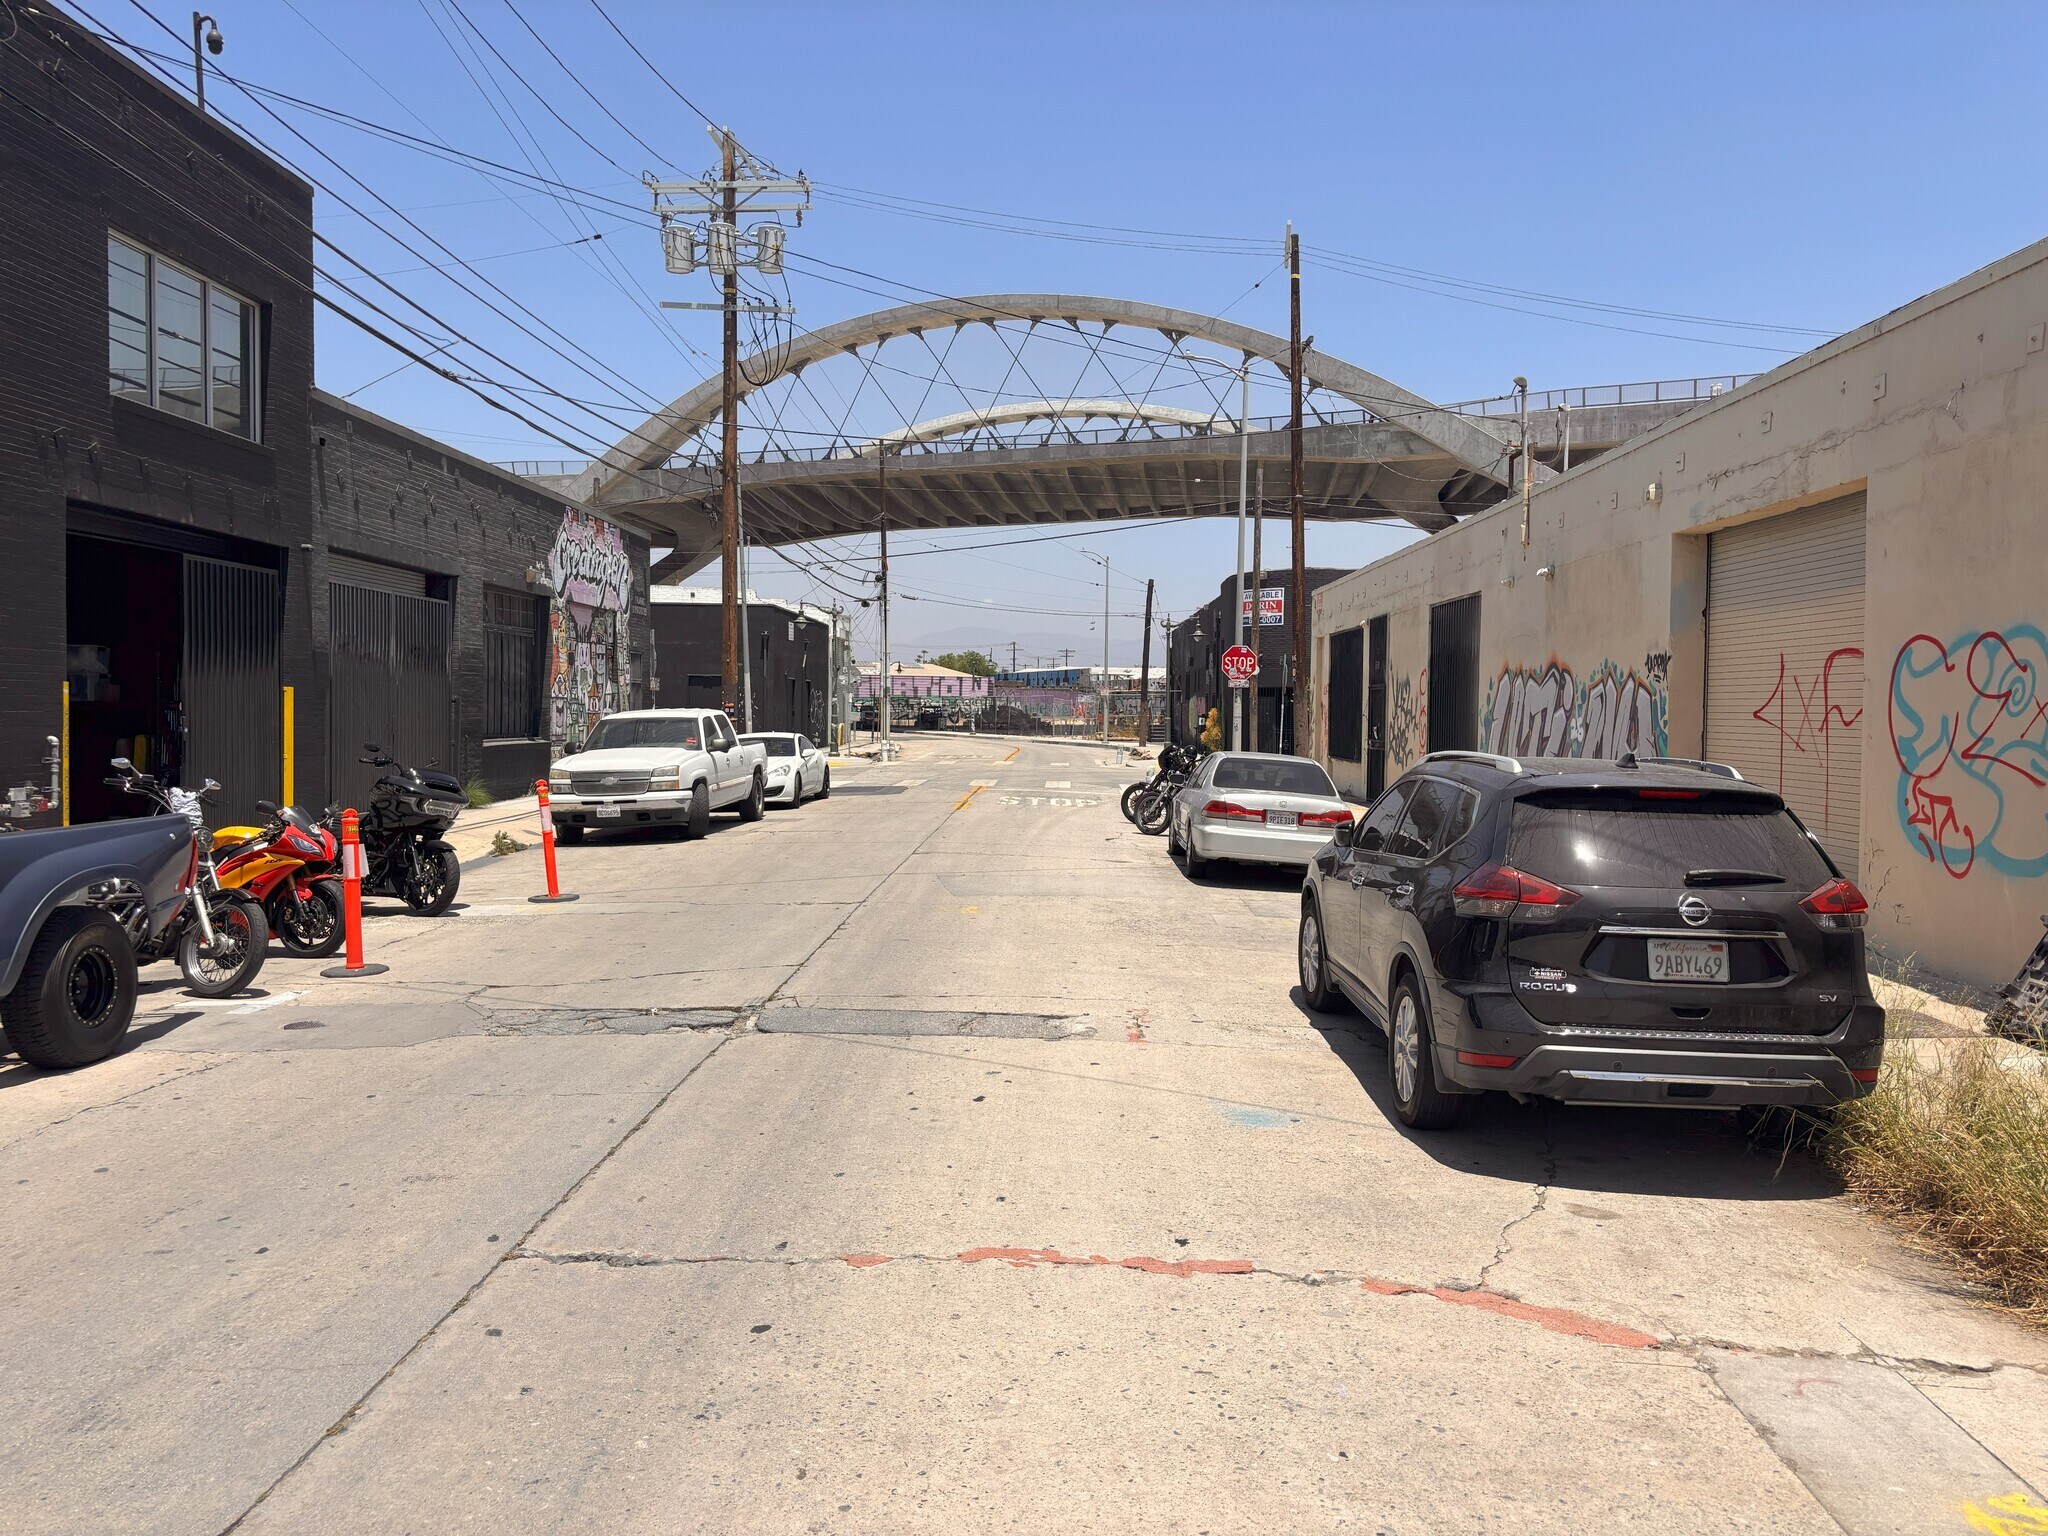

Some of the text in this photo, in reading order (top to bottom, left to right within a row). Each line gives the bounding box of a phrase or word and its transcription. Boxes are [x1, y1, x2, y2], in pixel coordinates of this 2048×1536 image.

[1245, 591, 1279, 600] AVABLE
[1246, 601, 1277, 610] DRIN
[1224, 656, 1255, 670] STOP
[997, 796, 1104, 807] STOP
[1664, 942, 1707, 955] California
[1655, 954, 1723, 975] 9ABY469
[1519, 982, 1577, 993] ROGU
[1819, 994, 1837, 1002] SV
